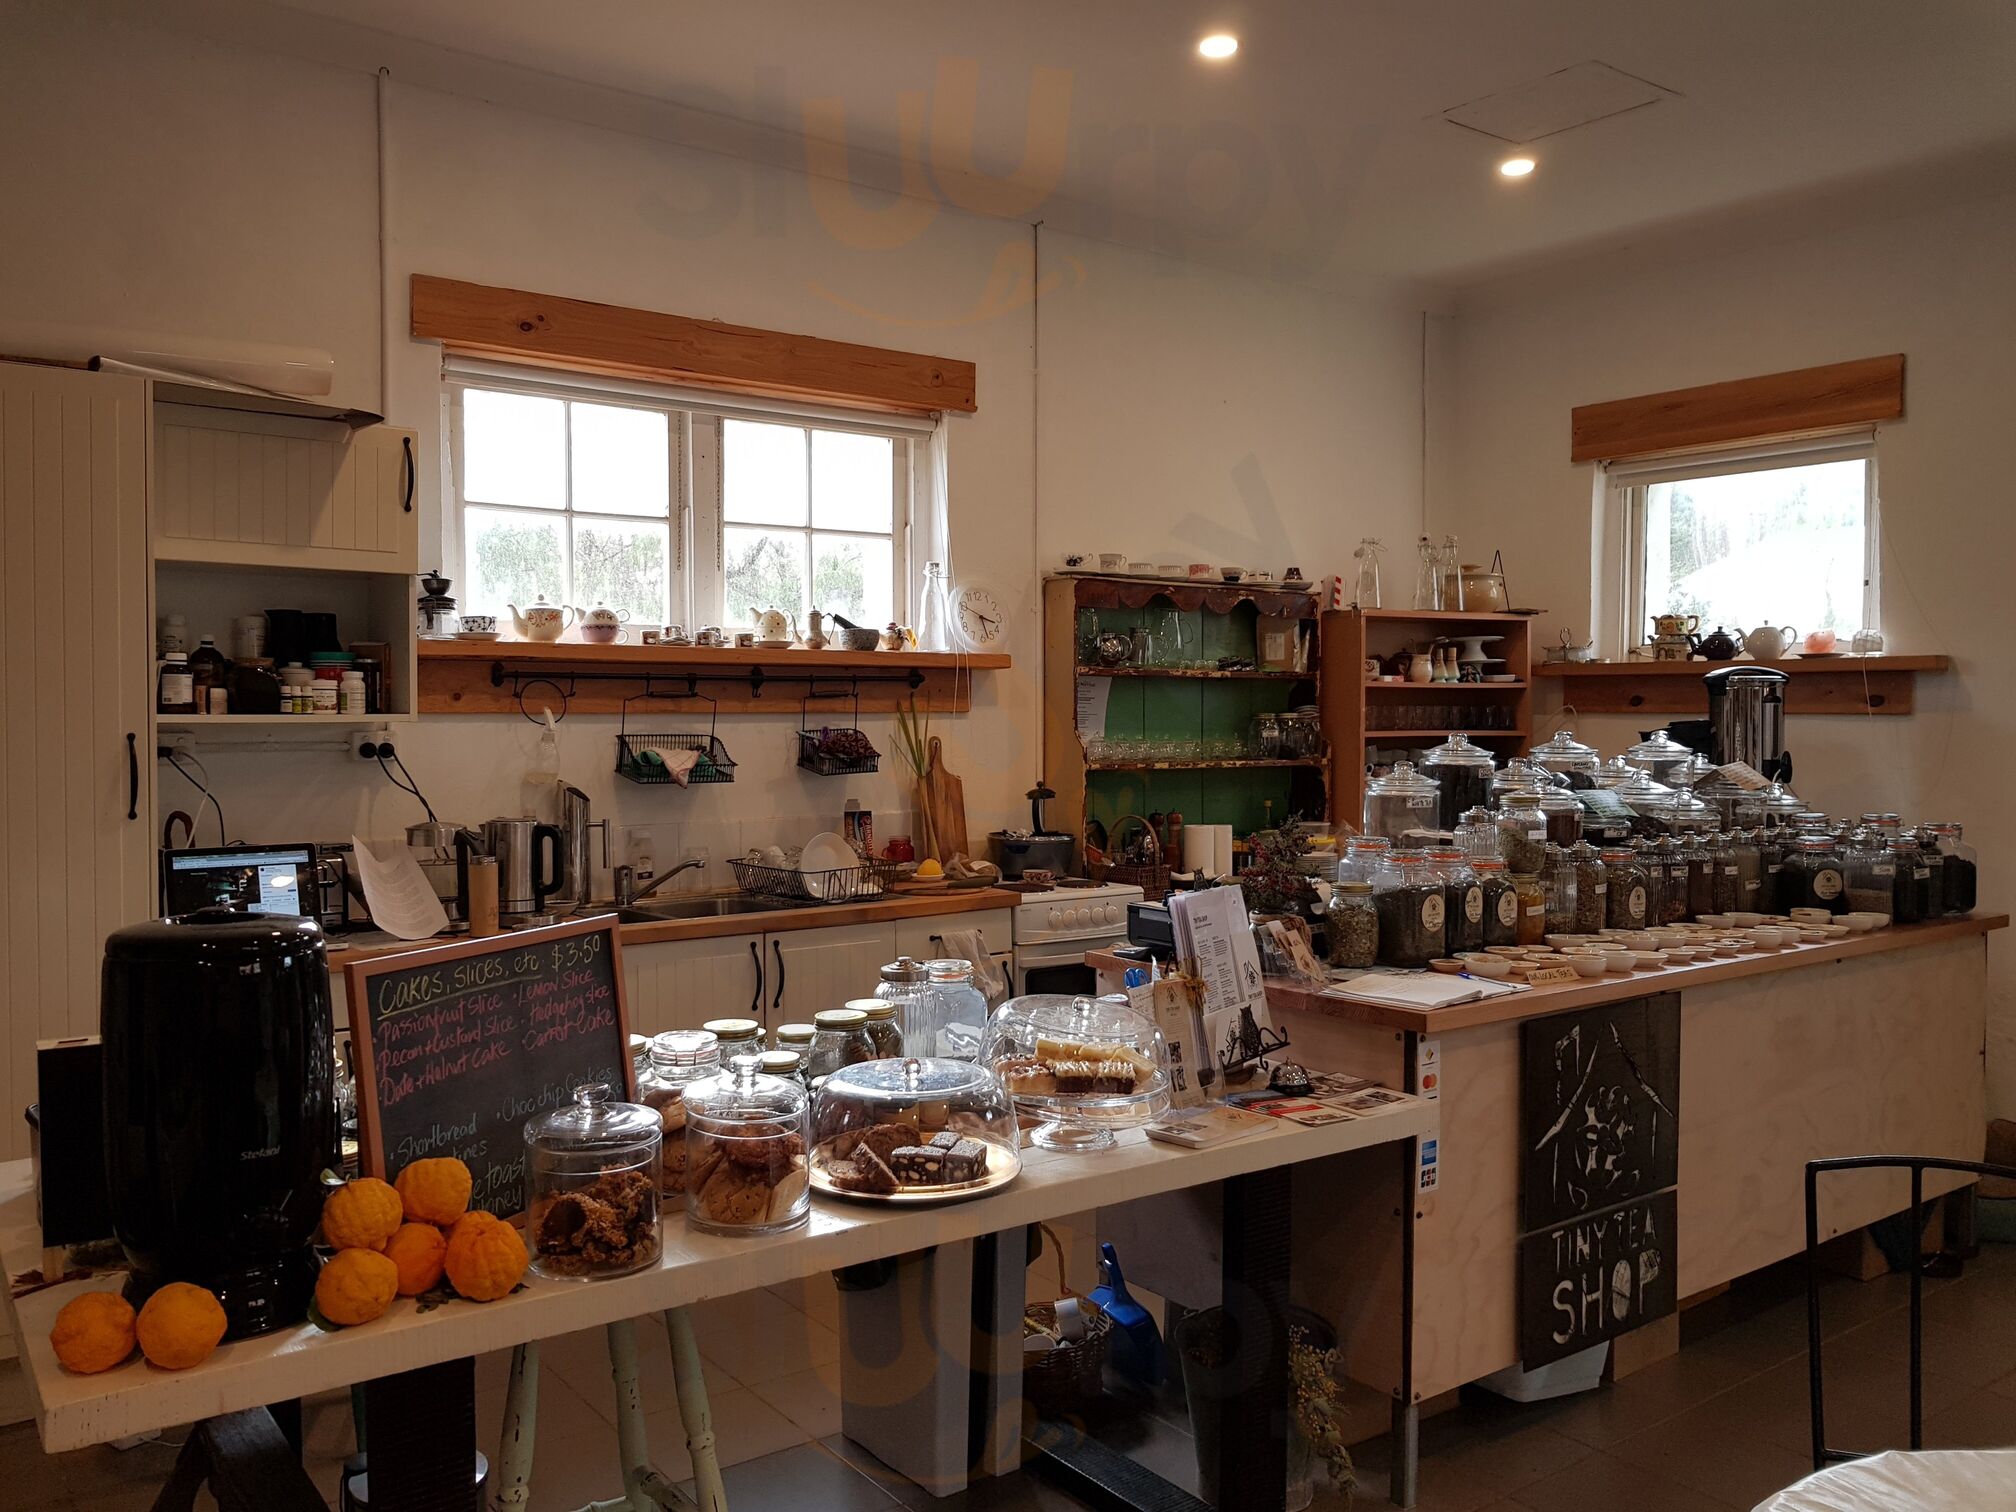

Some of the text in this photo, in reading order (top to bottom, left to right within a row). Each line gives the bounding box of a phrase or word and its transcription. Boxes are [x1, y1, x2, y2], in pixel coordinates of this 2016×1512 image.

[377, 998, 465, 1049] Passionfruit
[524, 1017, 569, 1050] Carrot
[397, 1112, 478, 1167] Shortbread
[1552, 1204, 1658, 1274] TINY TEA
[1551, 1248, 1663, 1345] SHOP
